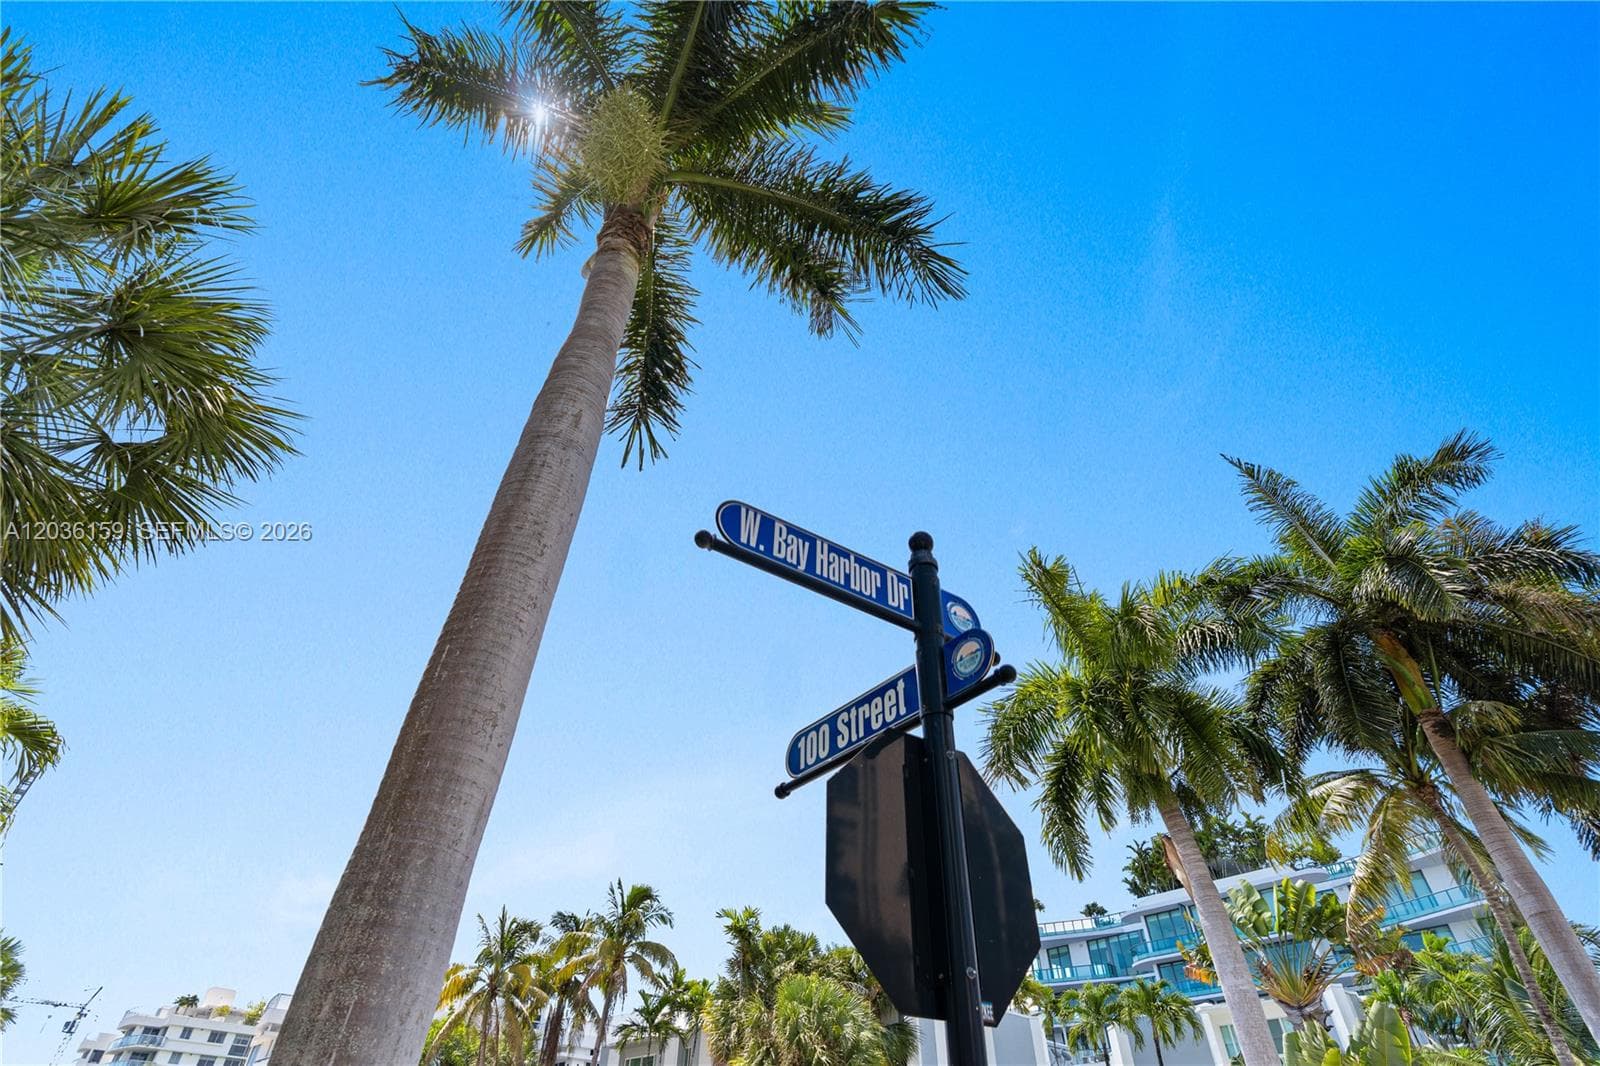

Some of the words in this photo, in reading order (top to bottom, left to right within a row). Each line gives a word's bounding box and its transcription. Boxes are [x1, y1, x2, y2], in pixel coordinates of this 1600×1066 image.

[740, 505, 765, 552] W.
[773, 520, 810, 571] Bay
[815, 539, 881, 599] Harbor
[886, 570, 909, 611] Dr
[798, 723, 830, 770] 100
[836, 678, 906, 749] Street
